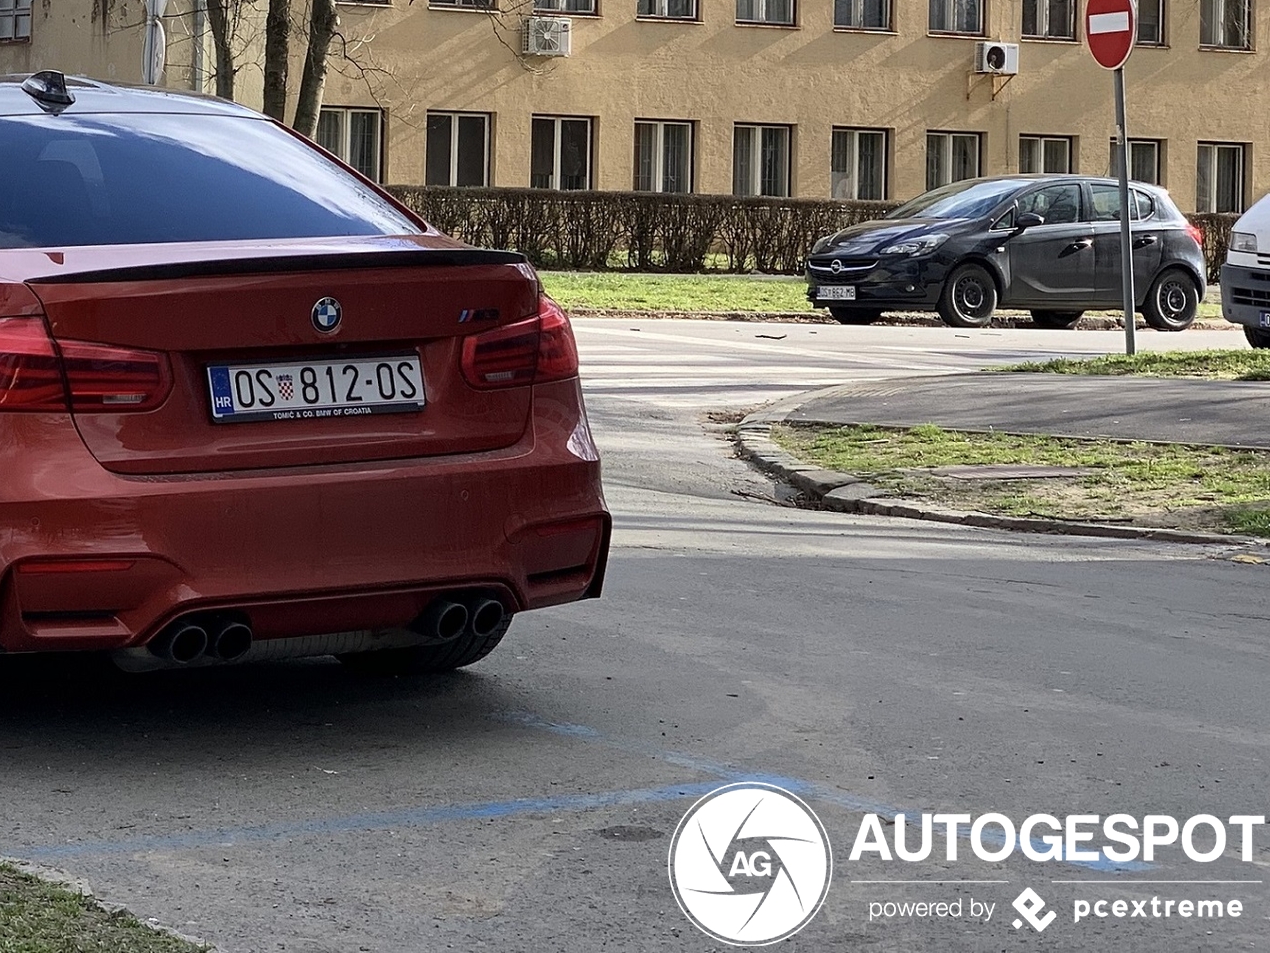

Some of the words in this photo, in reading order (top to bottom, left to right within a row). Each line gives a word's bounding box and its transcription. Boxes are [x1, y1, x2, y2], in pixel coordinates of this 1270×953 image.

[234, 369, 275, 409] OS
[299, 361, 417, 405] 812-OS
[216, 397, 232, 408] HR
[302, 410, 314, 418] CO.
[344, 407, 372, 415] CROATIA
